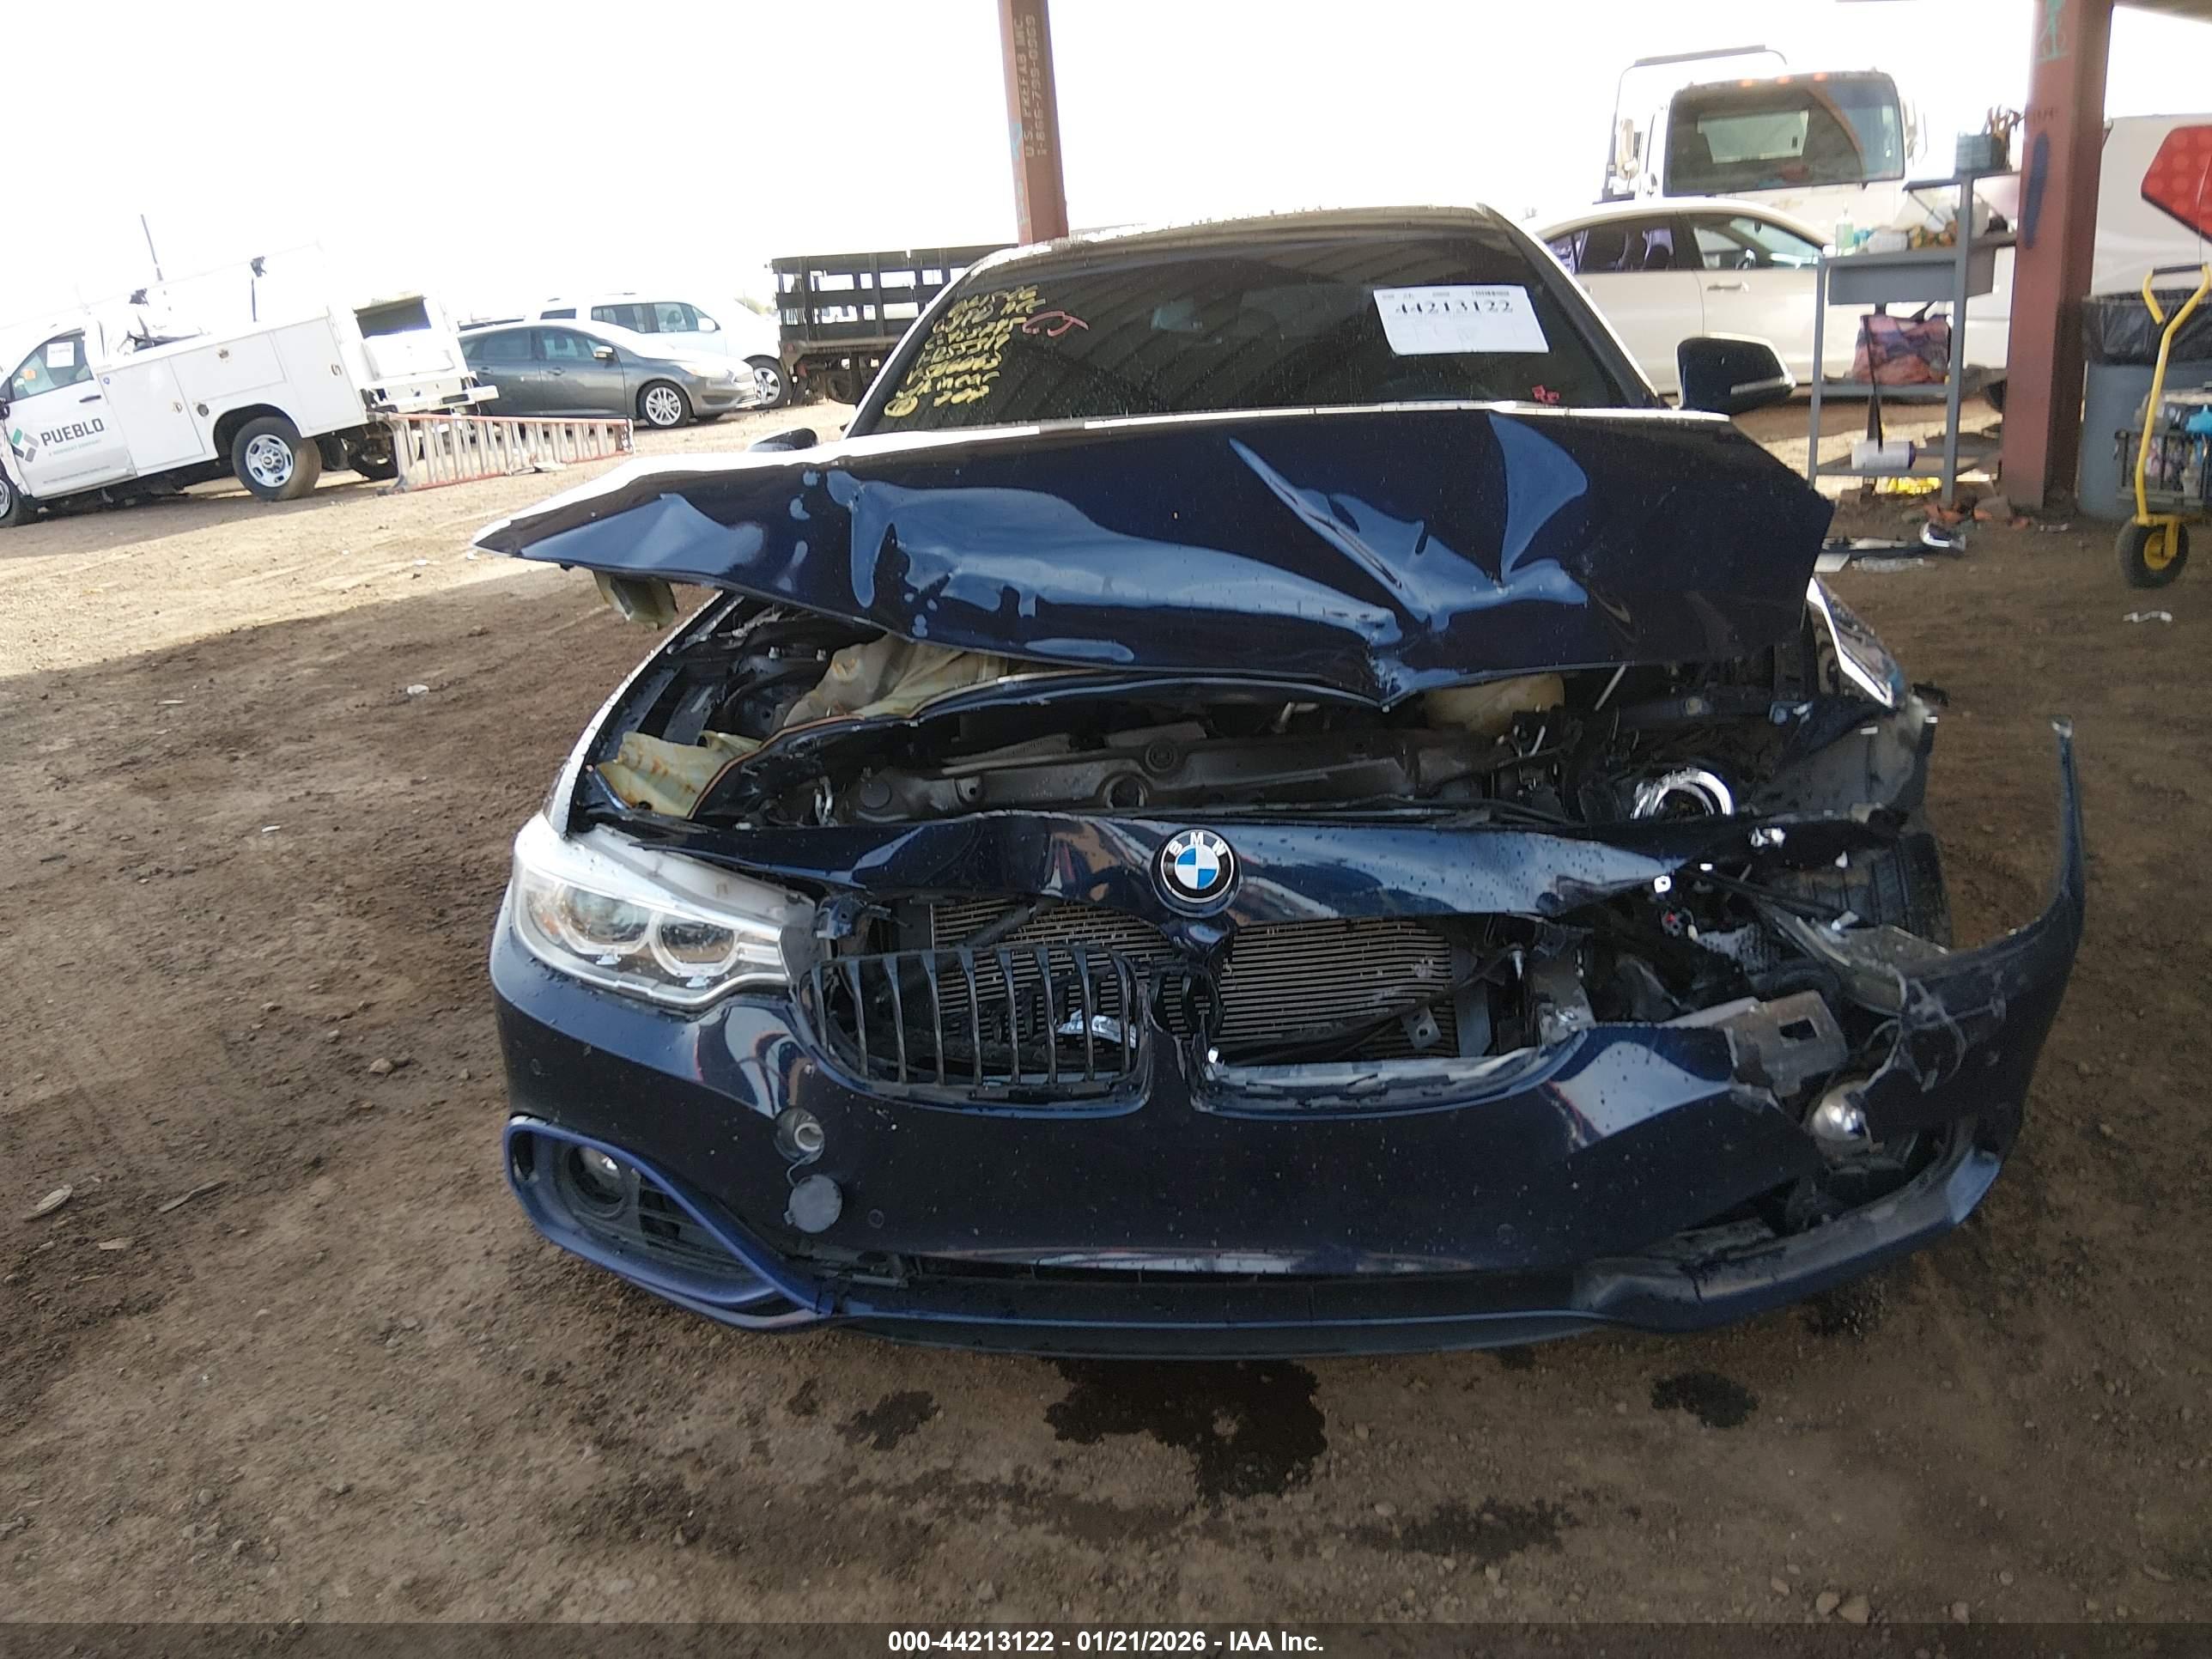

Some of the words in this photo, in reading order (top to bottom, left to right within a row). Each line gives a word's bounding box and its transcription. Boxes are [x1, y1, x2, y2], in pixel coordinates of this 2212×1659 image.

[1395, 300, 1514, 315] 44213122
[40, 417, 105, 447] PUEBLO
[1168, 831, 1228, 857] BMW
